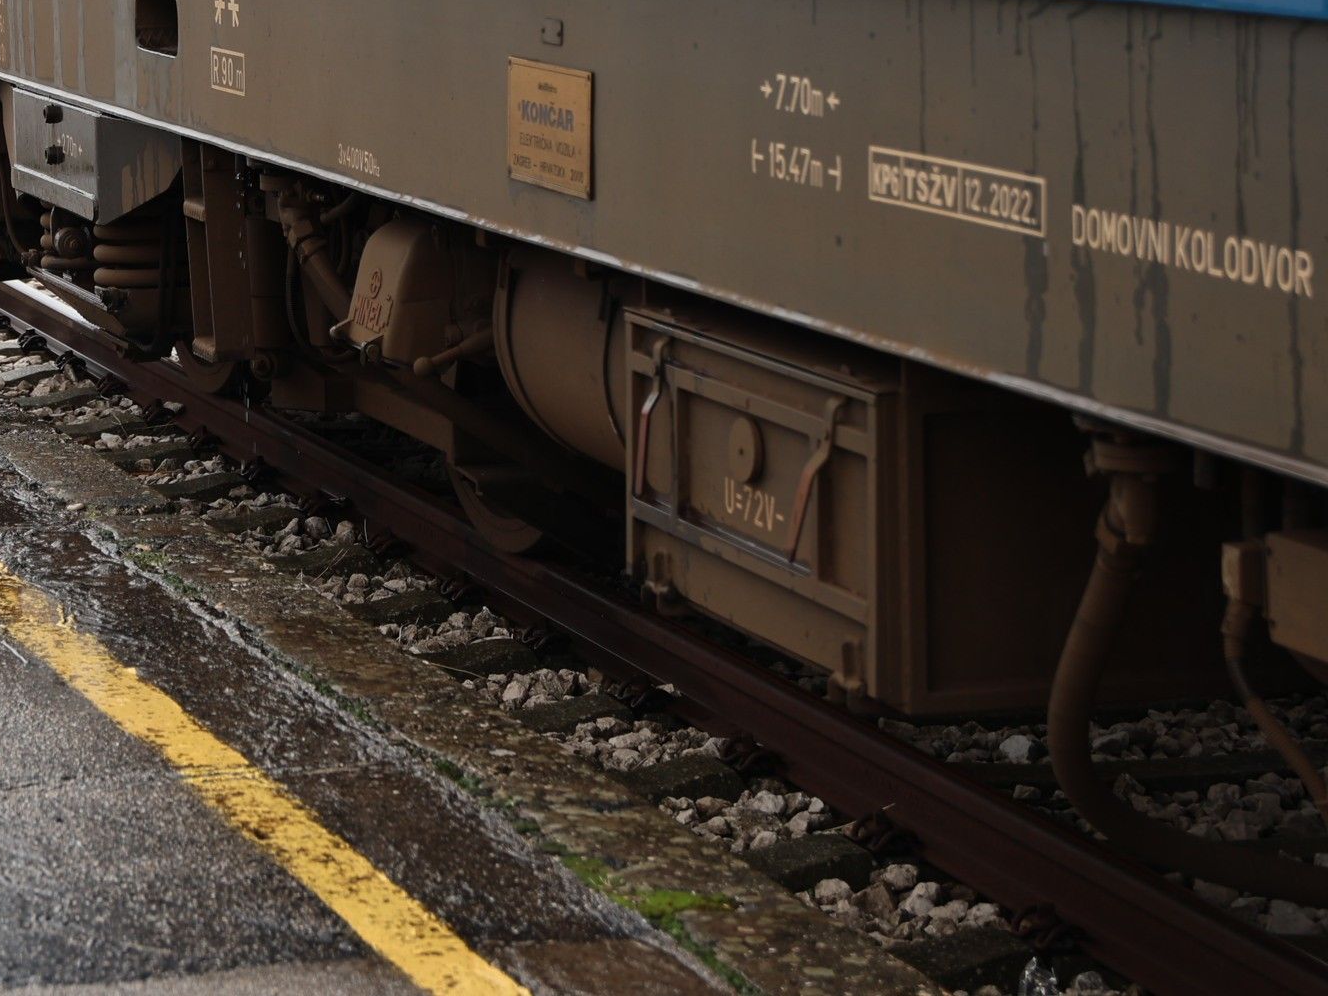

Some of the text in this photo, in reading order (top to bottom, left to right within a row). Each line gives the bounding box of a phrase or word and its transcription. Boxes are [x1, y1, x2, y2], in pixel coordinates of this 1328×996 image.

[213, 54, 245, 90] R 90 m
[521, 99, 575, 132] KONČAR
[774, 73, 824, 118] 7.70m
[768, 142, 824, 189] 15.47m
[872, 162, 1038, 225] KP6 TSŽV 12.2022.
[1072, 204, 1315, 299] DOMOVNI KOLODVOR
